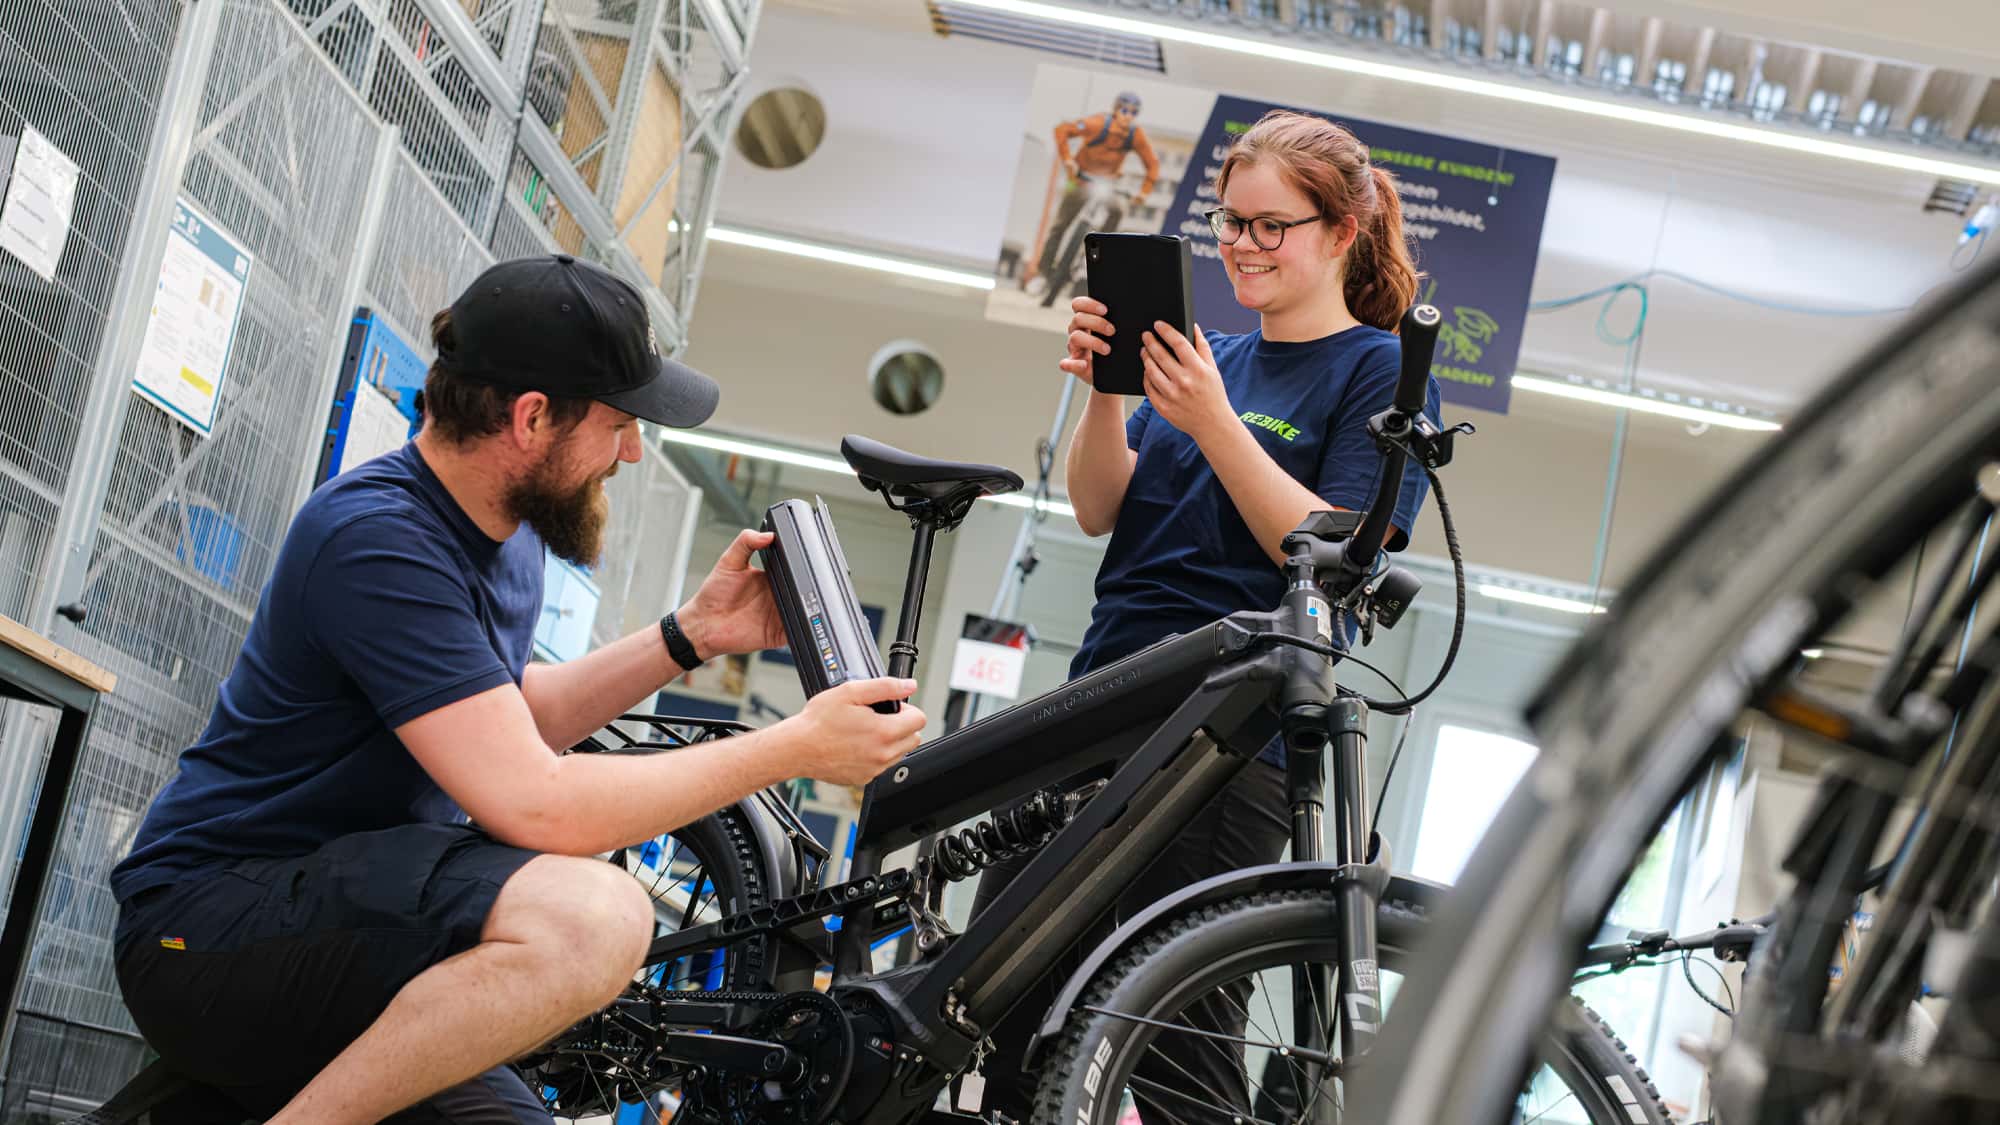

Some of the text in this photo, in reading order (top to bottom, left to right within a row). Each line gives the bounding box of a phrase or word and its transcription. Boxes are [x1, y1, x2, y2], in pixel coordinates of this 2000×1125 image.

[1430, 364, 1495, 388] CADEMY
[1239, 411, 1301, 441] REBIKE
[967, 655, 1006, 686] 46
[1076, 1035, 1113, 1125] LBE
